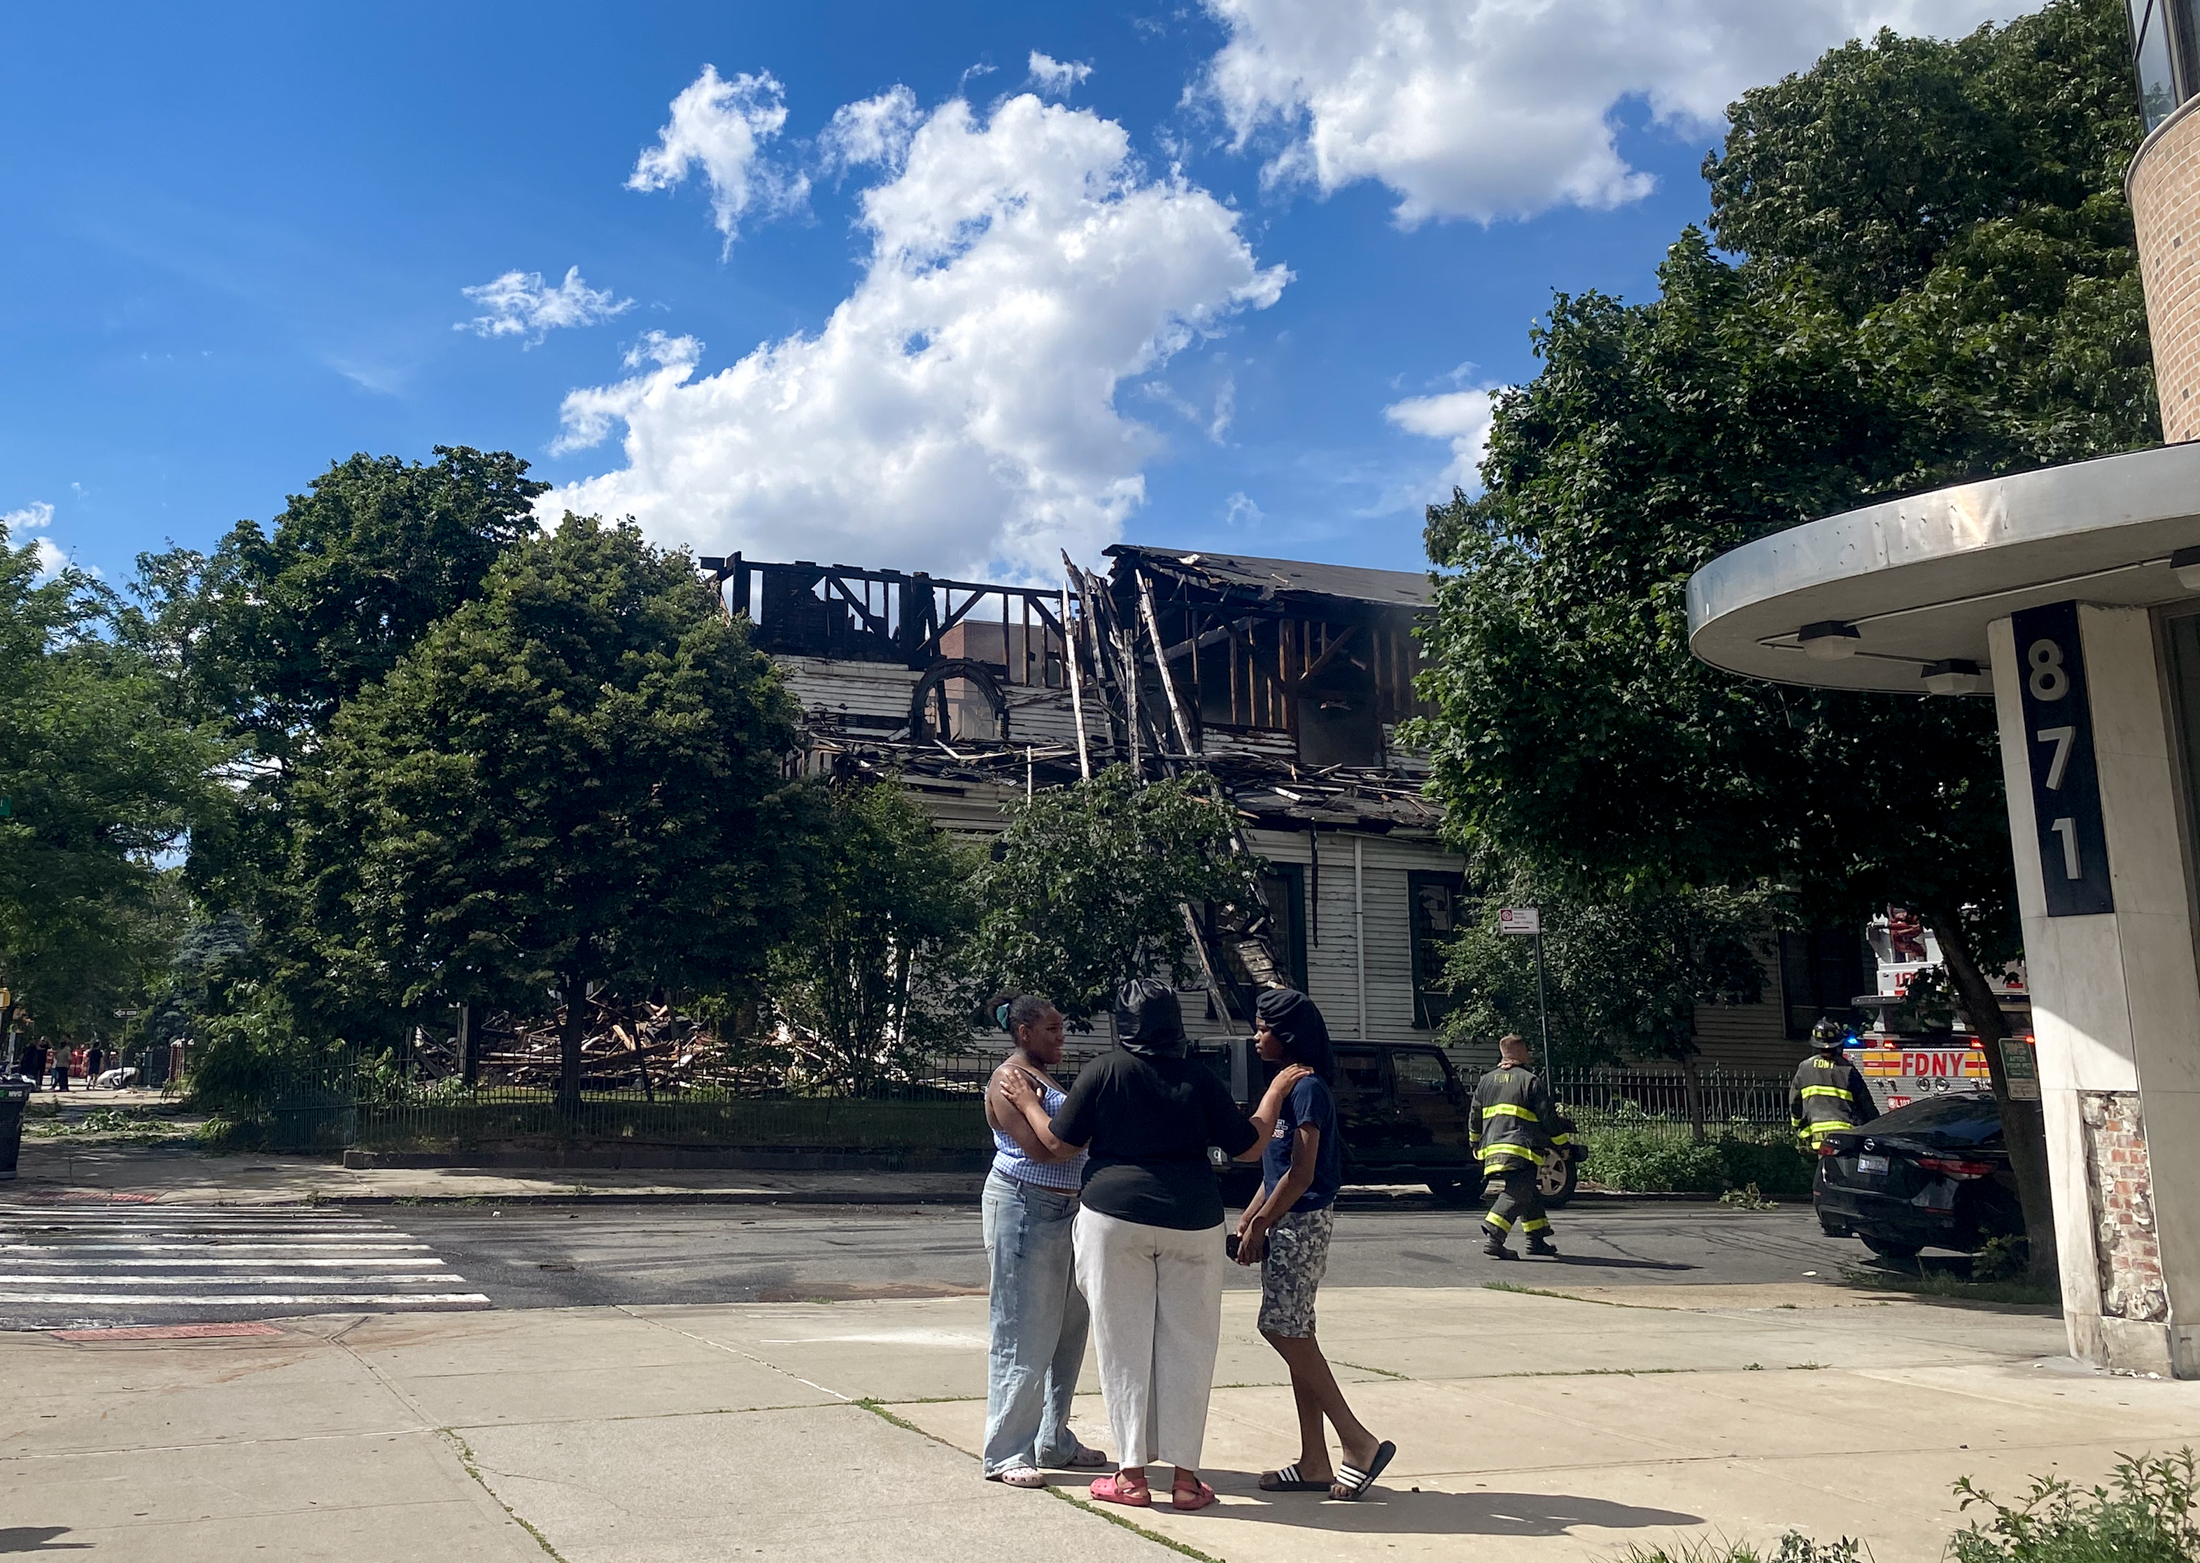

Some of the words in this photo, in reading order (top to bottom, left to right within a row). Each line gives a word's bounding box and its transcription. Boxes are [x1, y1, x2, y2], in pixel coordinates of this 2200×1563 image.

[2028, 638, 2083, 881] 871
[1813, 1058, 1835, 1070] FDNY
[1901, 1053, 1965, 1077] FDNY
